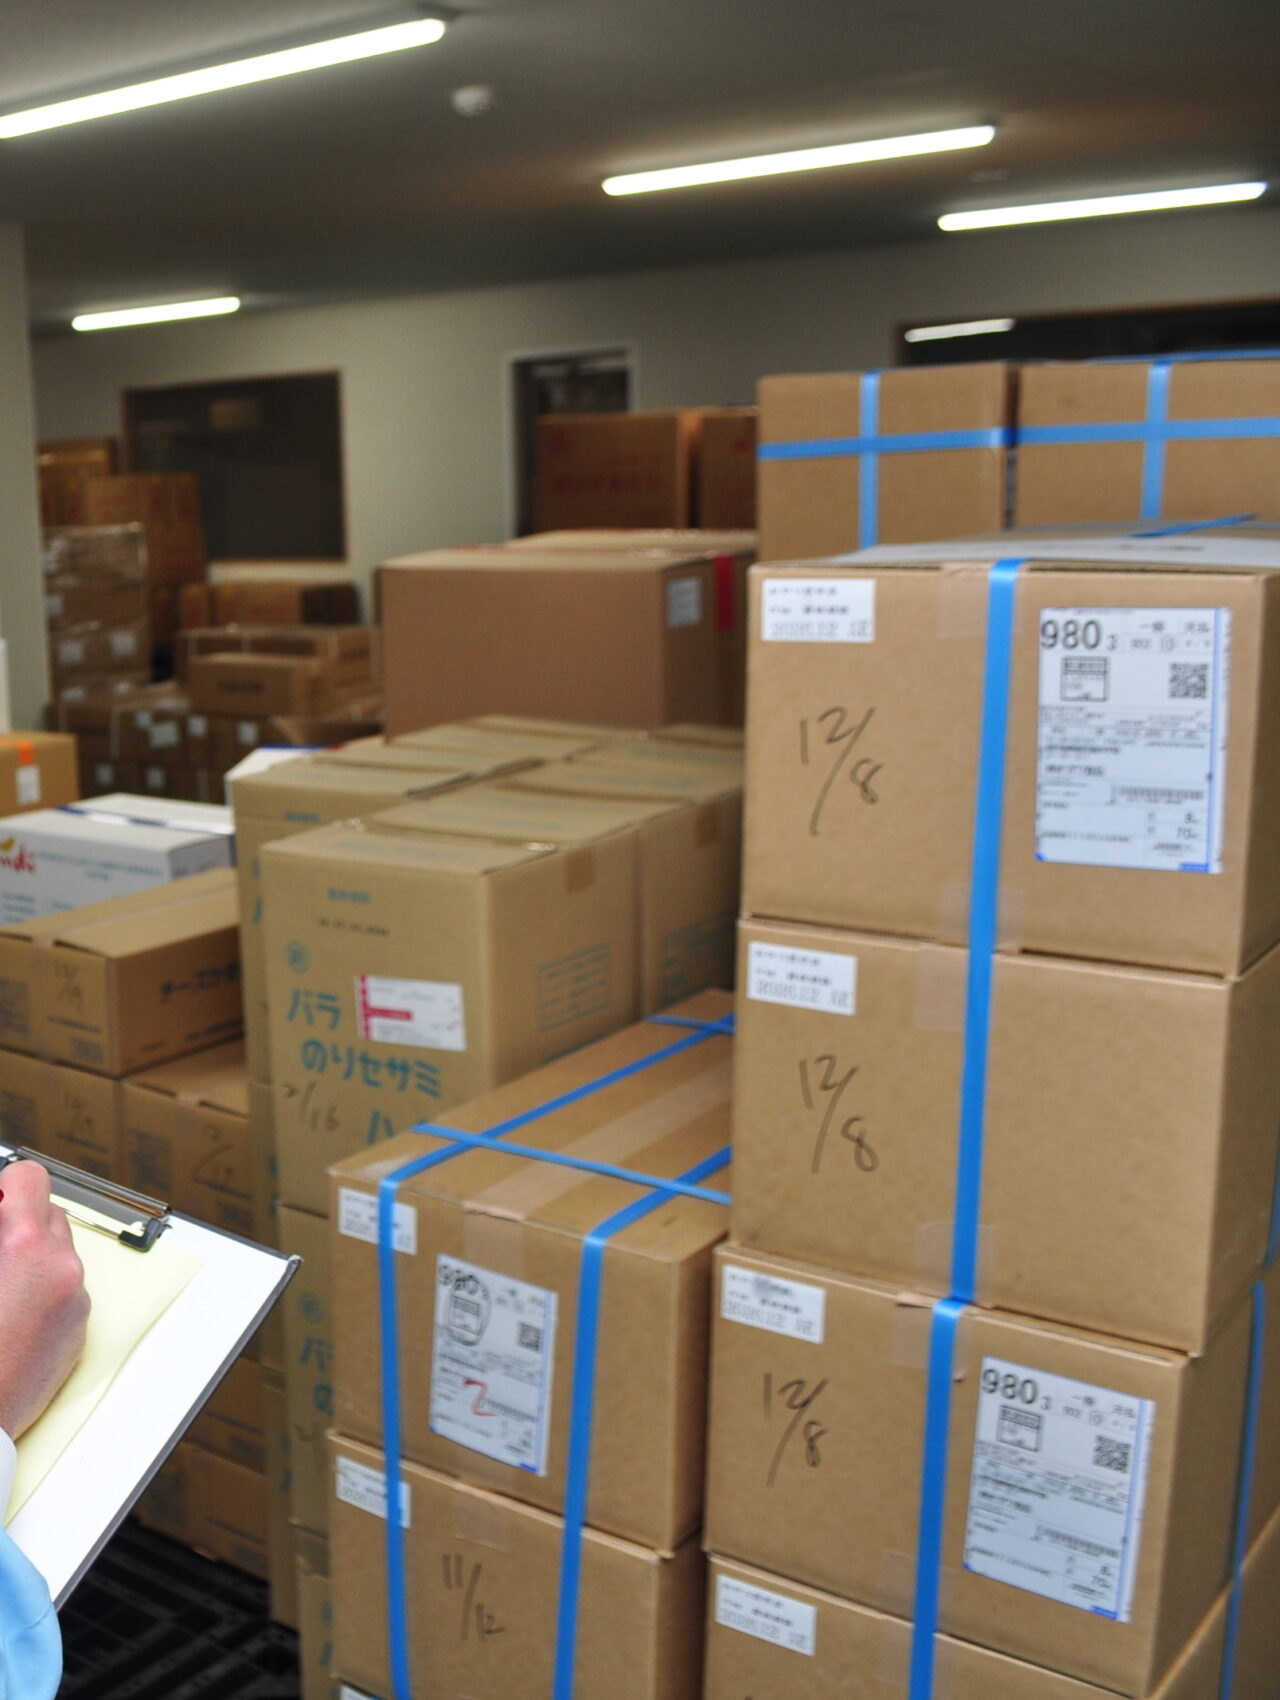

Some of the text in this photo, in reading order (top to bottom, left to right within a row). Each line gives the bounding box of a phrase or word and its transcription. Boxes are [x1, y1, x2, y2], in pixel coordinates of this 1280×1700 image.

[1040, 619, 1102, 650] 980
[799, 706, 883, 837] 12/8
[301, 1037, 443, 1100] のりセサミ
[799, 1054, 878, 1174] 12/8
[981, 1368, 1039, 1405] 980
